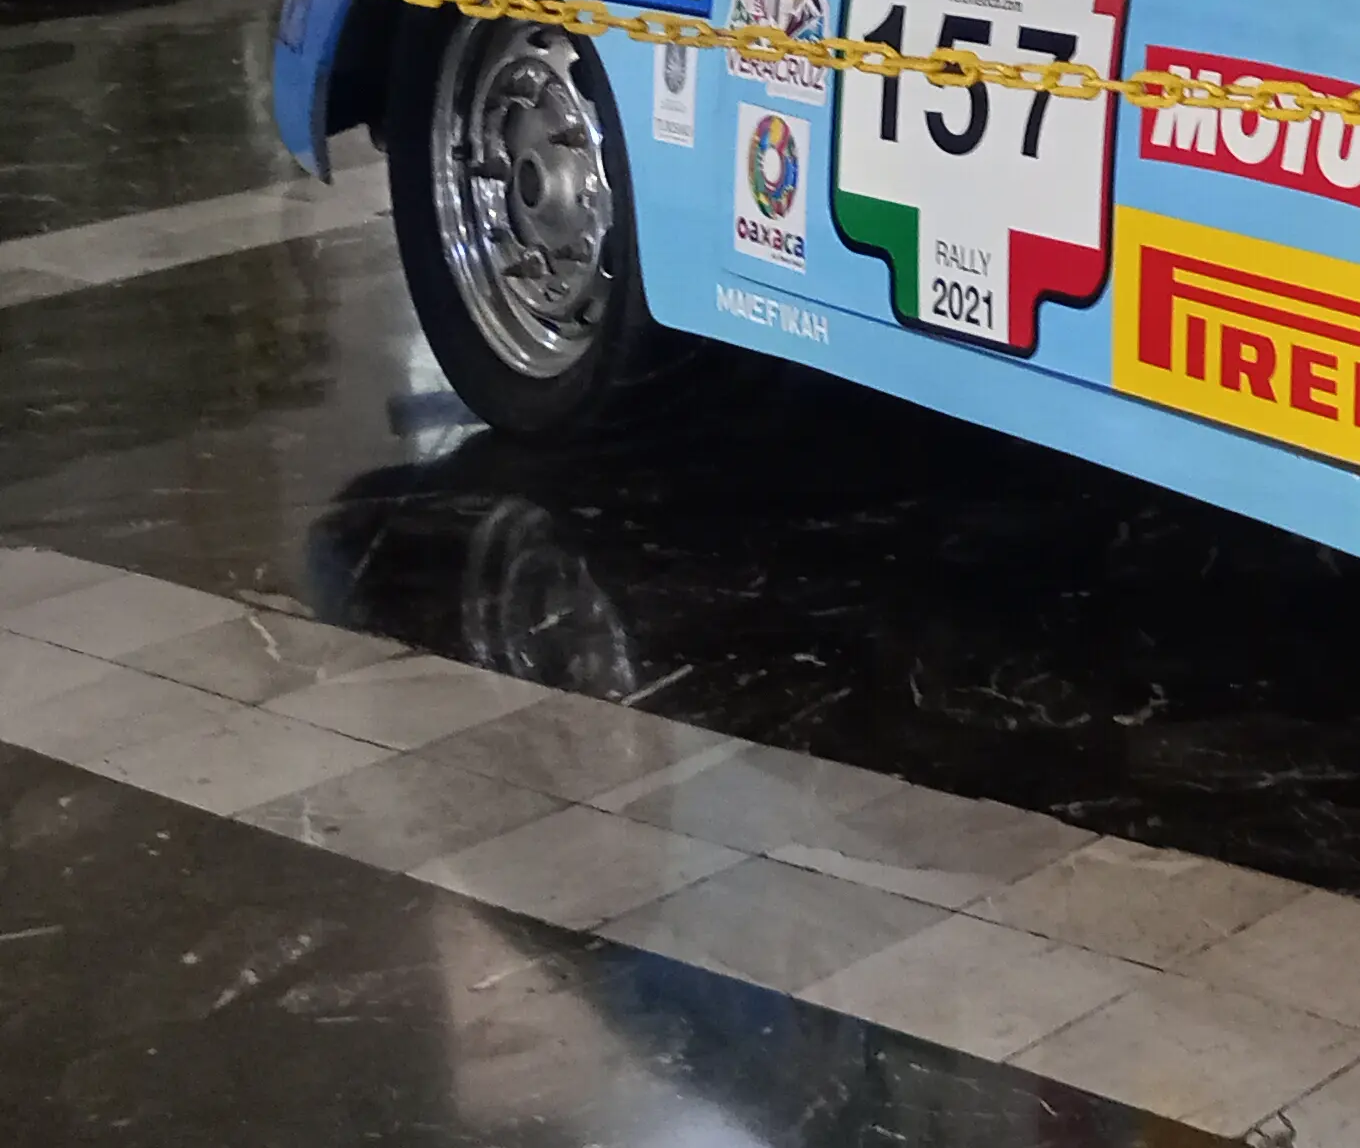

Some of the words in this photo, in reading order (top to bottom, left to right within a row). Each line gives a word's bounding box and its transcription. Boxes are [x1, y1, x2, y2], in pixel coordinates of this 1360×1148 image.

[864, 5, 1079, 159] 157
[736, 216, 806, 260] oaxaca
[935, 240, 992, 275] RALLY
[931, 278, 995, 330] 2021
